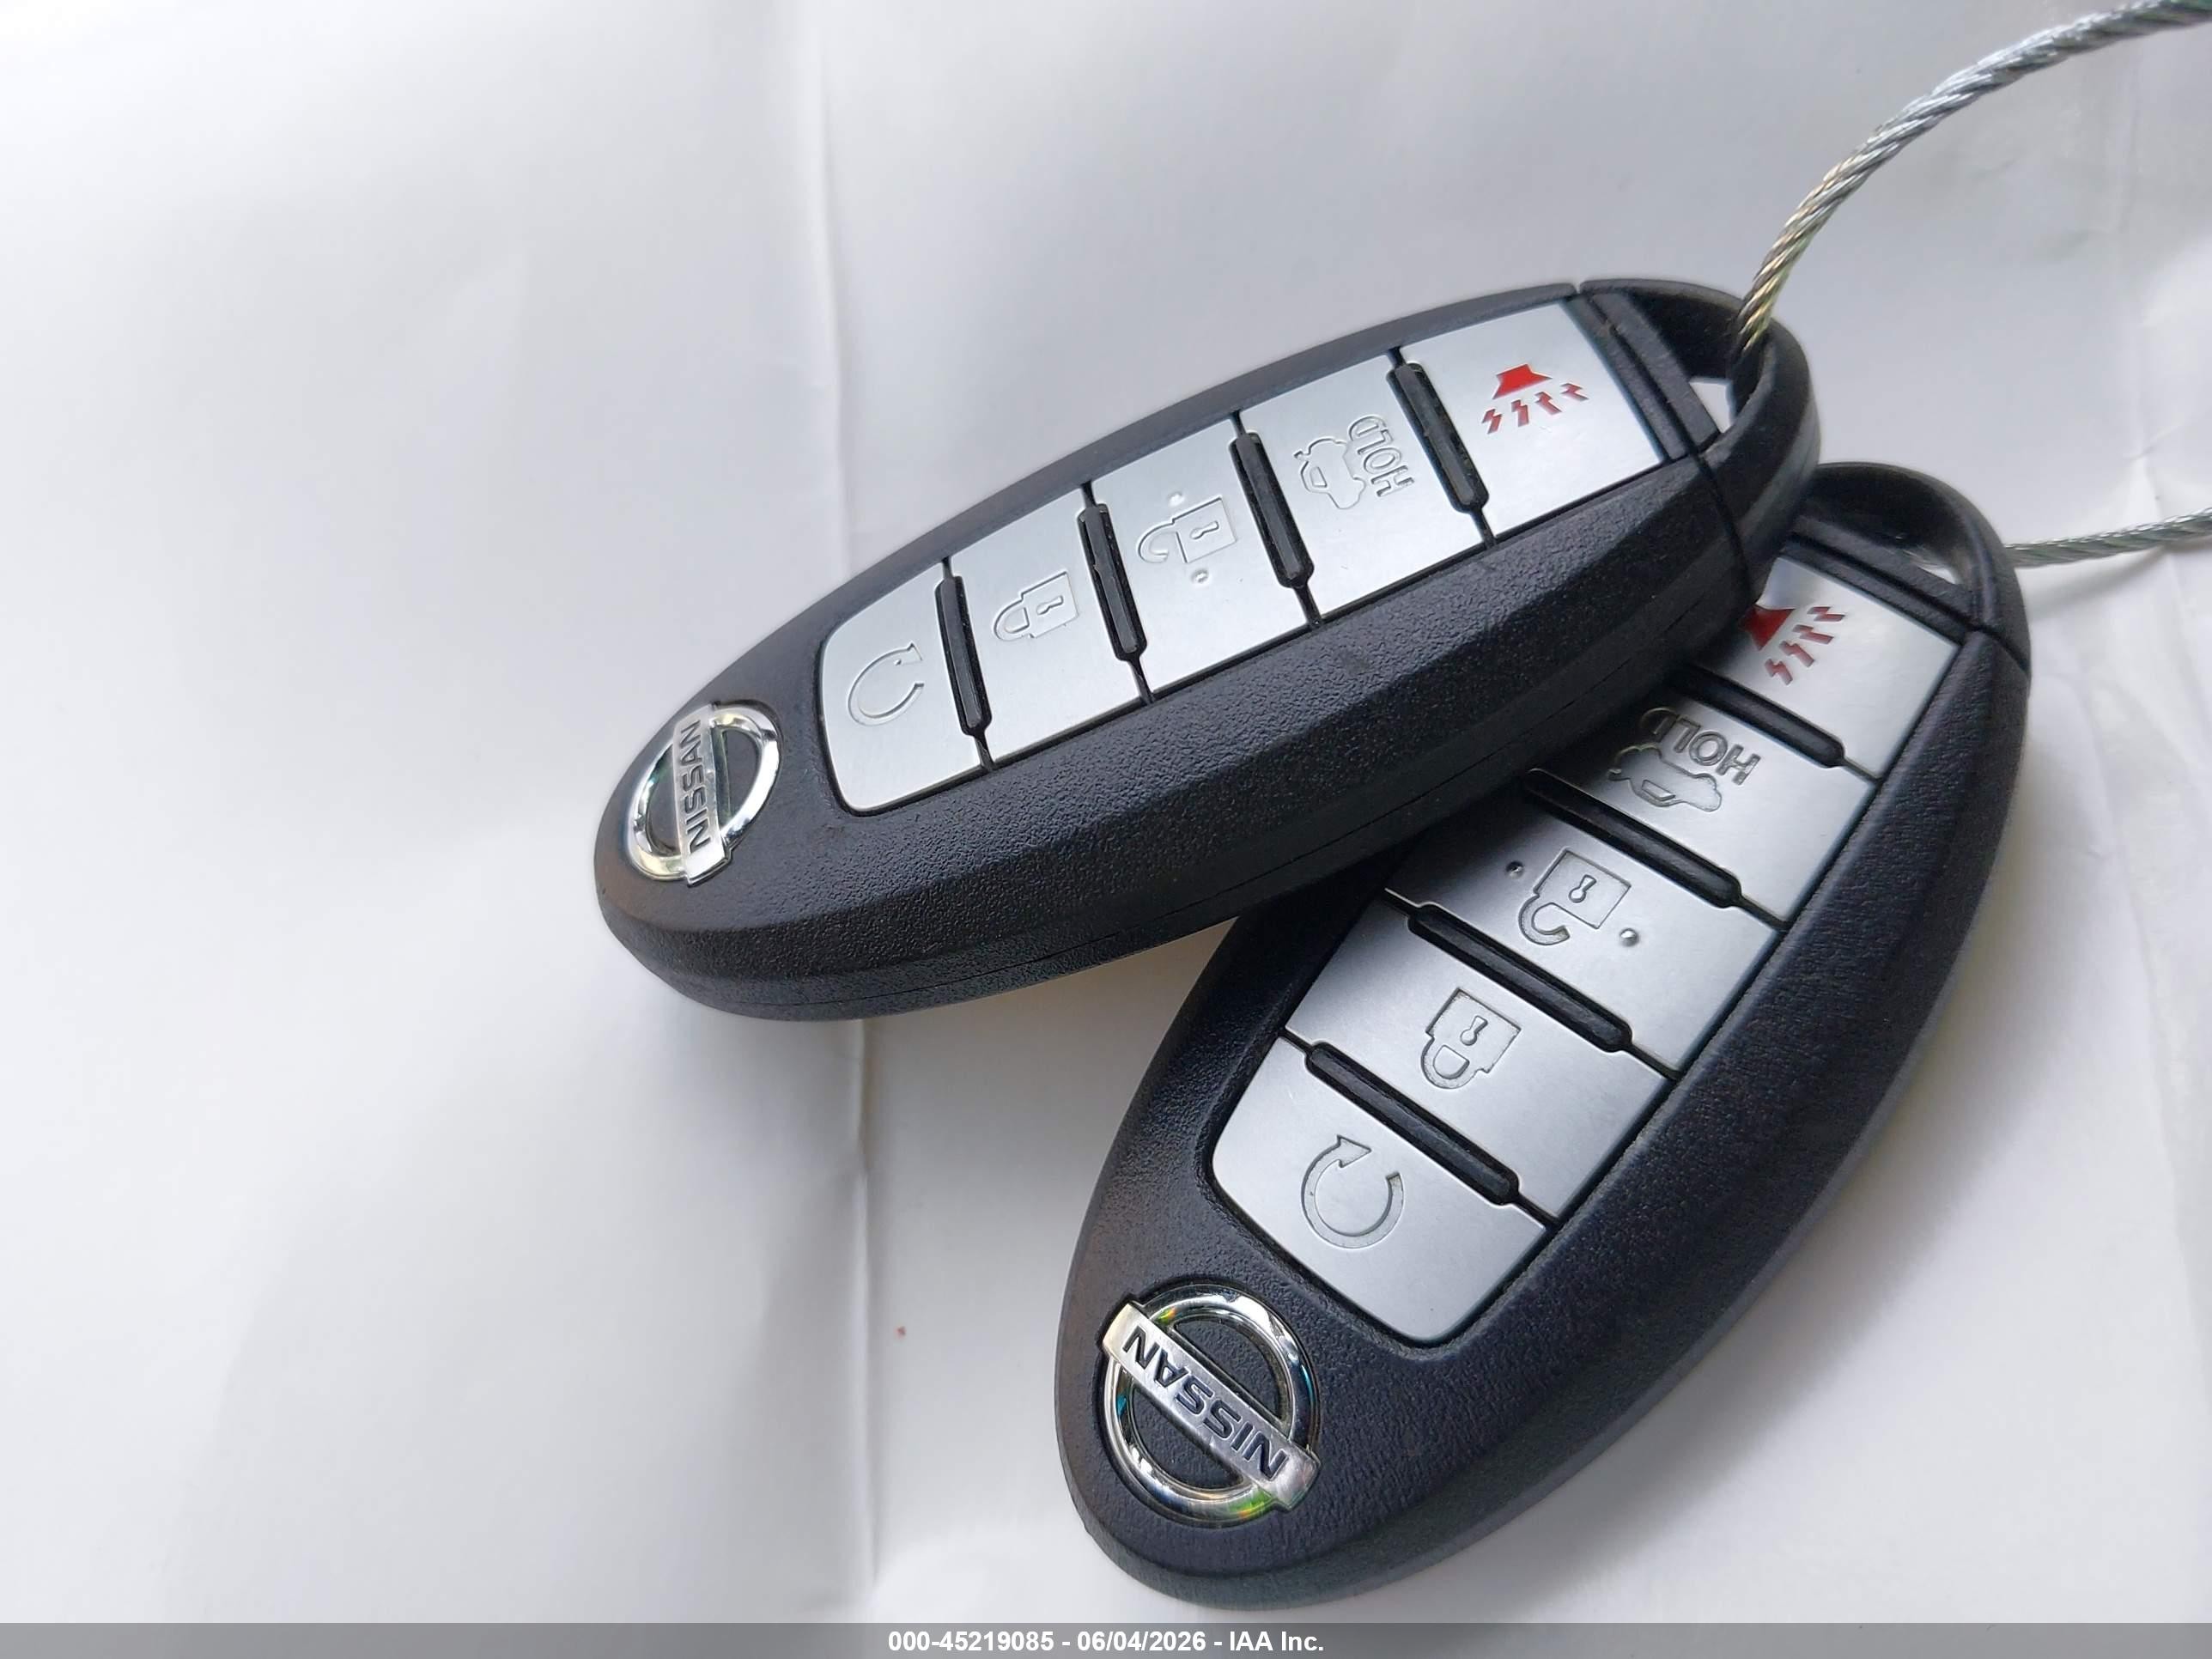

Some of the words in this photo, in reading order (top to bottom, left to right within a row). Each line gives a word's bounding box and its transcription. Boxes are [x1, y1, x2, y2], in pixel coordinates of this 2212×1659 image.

[1347, 415, 1414, 497] HOLD
[679, 720, 712, 854] NISSAN
[1639, 707, 1761, 786] HOLD
[1122, 1325, 1288, 1480] NISSAN
